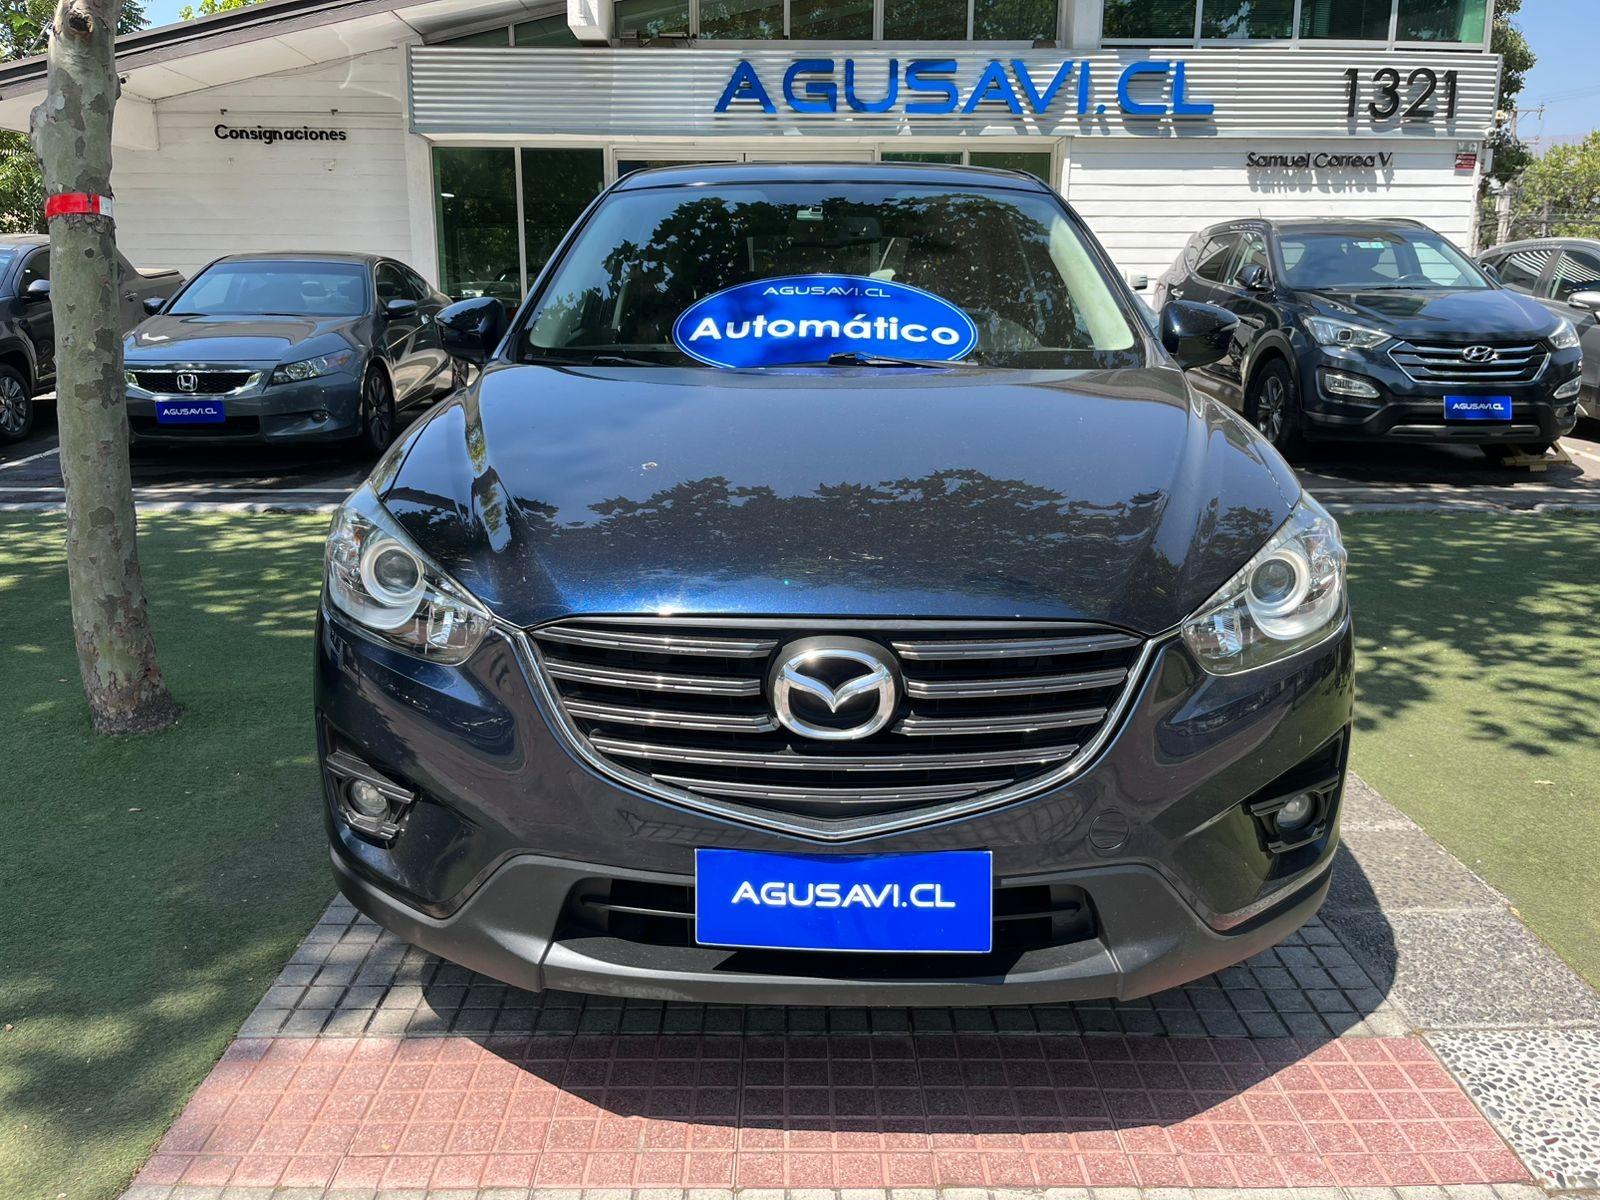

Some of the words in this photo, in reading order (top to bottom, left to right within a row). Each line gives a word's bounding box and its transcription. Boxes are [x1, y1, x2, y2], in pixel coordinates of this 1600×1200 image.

[714, 59, 1215, 115] AGUSAVI.CL
[1344, 67, 1458, 119] 1321
[214, 124, 347, 145] Consignaciones
[1246, 152, 1310, 168] Samuel
[1314, 152, 1375, 168] Correa
[762, 286, 891, 298] AGUSAVI.CL
[688, 313, 961, 346] Automático
[162, 407, 218, 416] AGUSAVI.CL
[1452, 402, 1505, 410] AGUSAVI.CL
[731, 880, 957, 908] AGUSAVI.CL
